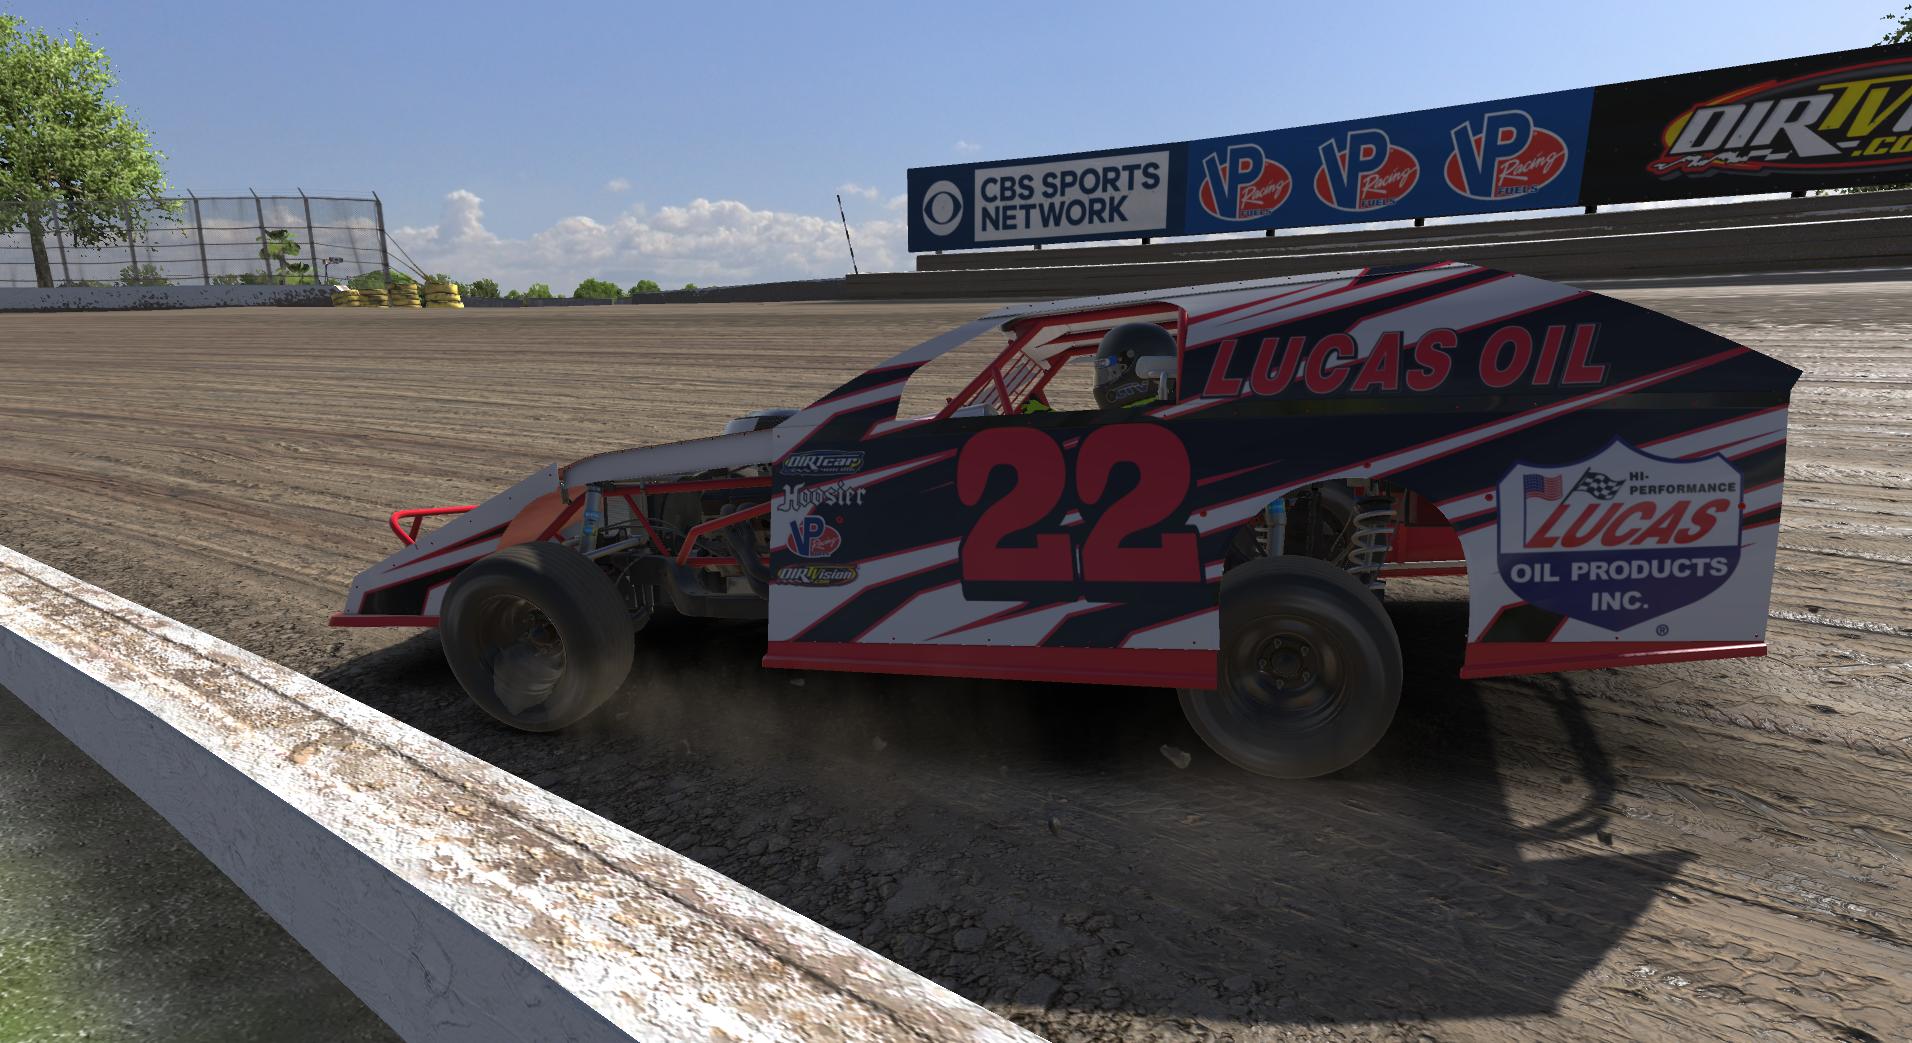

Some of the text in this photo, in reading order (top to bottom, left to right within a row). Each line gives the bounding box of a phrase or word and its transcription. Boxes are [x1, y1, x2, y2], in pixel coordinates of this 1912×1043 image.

[1319, 129, 1390, 211] VP
[1451, 110, 1533, 200] VP
[1499, 151, 1566, 186] Racing
[981, 162, 1160, 203] CBS SPORTS
[1203, 144, 1265, 220] VP
[1362, 167, 1417, 199] Racing
[981, 195, 1128, 232] NETWORK
[1203, 323, 1606, 397] LUCAS OIL
[779, 480, 867, 512] Hoosier
[1629, 471, 1649, 482] HI-
[1629, 482, 1737, 496] PERFORMANCE
[956, 422, 1201, 582] 22
[790, 515, 825, 558] VP
[1523, 498, 1731, 549] LUCAS
[1510, 557, 1728, 583] OIL PRODUCTS
[1592, 591, 1649, 611] INC.
